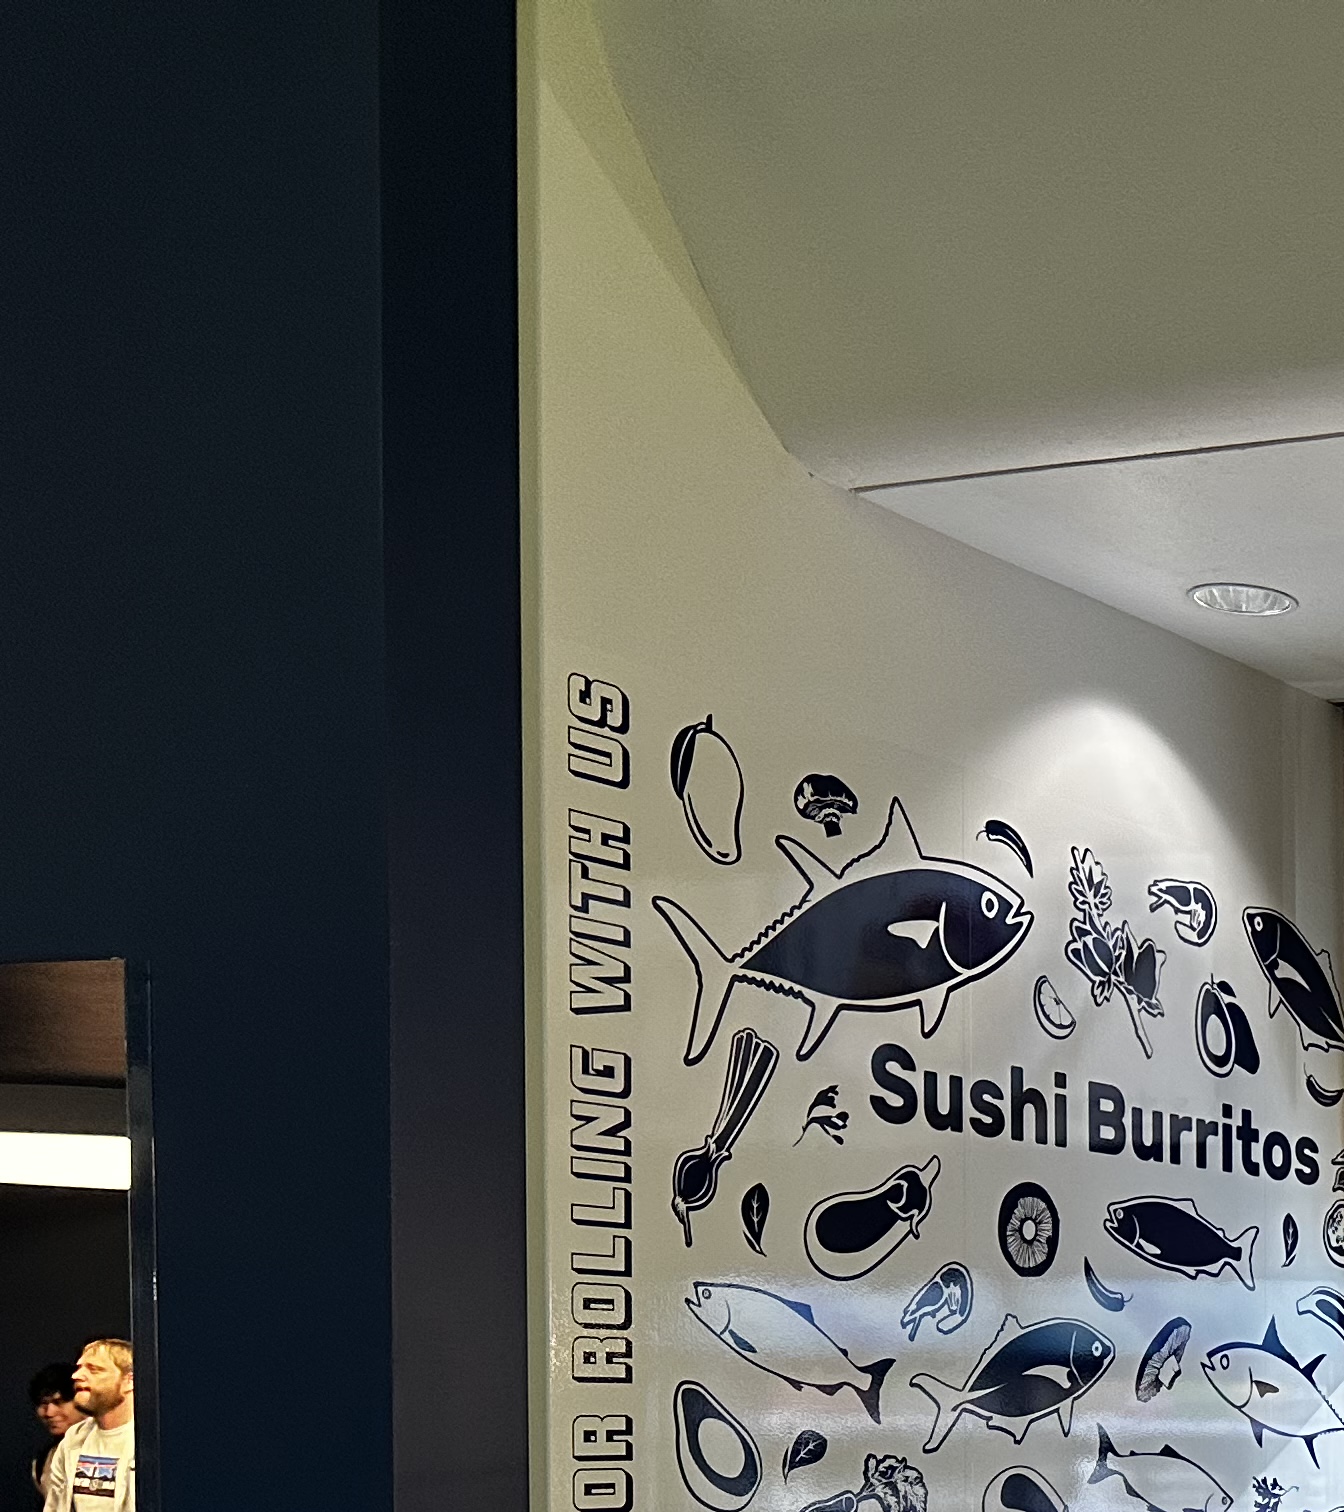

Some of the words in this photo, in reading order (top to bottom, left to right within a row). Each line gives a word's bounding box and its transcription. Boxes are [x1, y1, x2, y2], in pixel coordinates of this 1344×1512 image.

[568, 672, 631, 790] US
[568, 808, 632, 1015] WITH
[869, 1043, 1067, 1149] Sushi
[1087, 1081, 1321, 1185] Burritos
[569, 1045, 633, 1383] ROLLING
